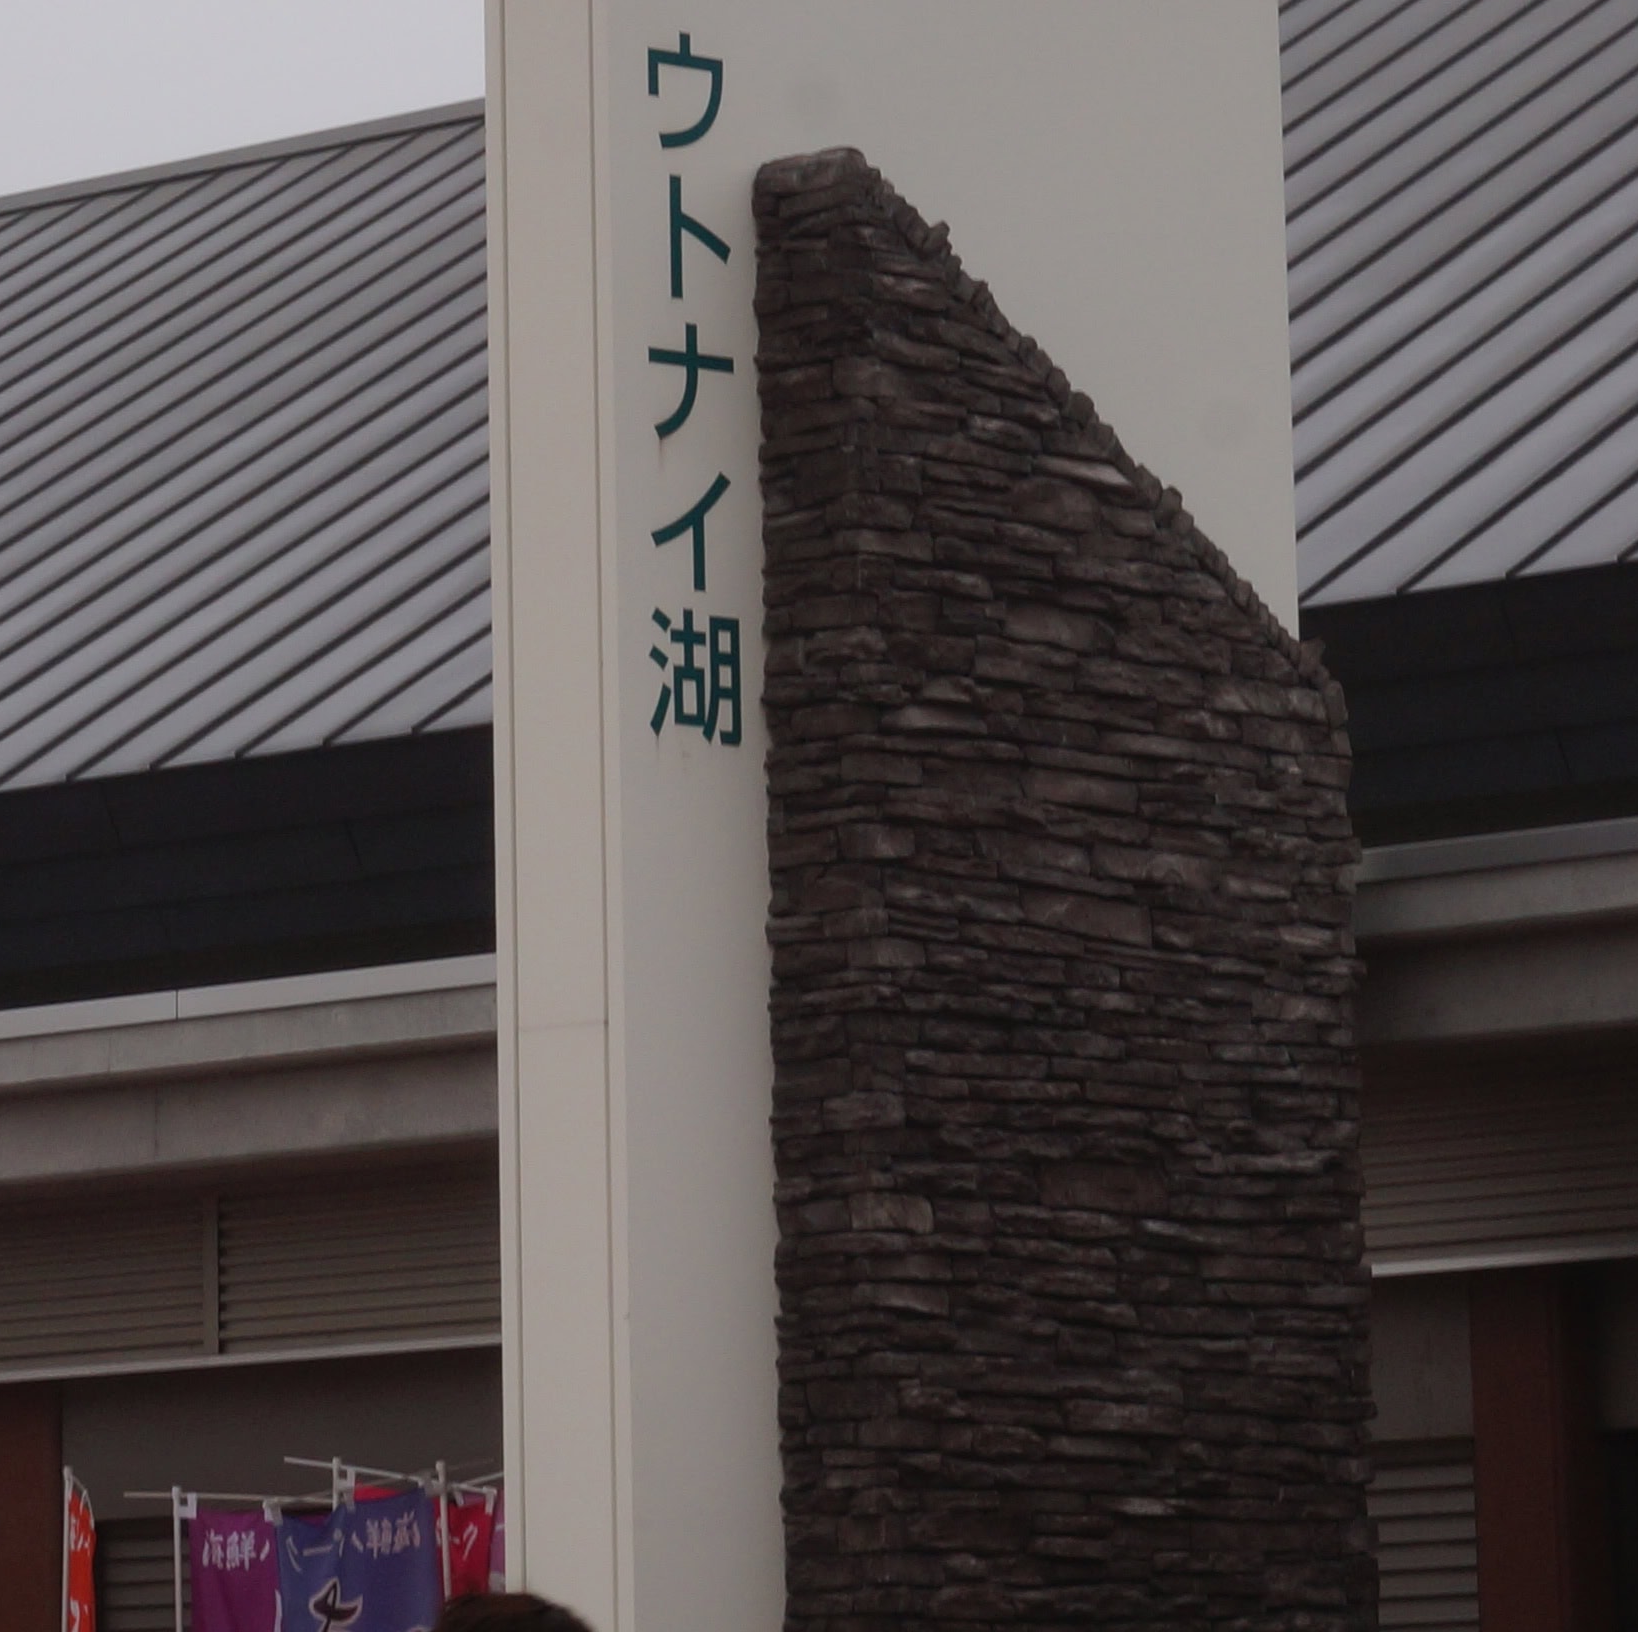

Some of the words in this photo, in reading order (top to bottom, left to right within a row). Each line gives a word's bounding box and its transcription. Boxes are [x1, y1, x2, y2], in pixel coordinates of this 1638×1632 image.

[647, 31, 742, 746] ウトナイ湖
